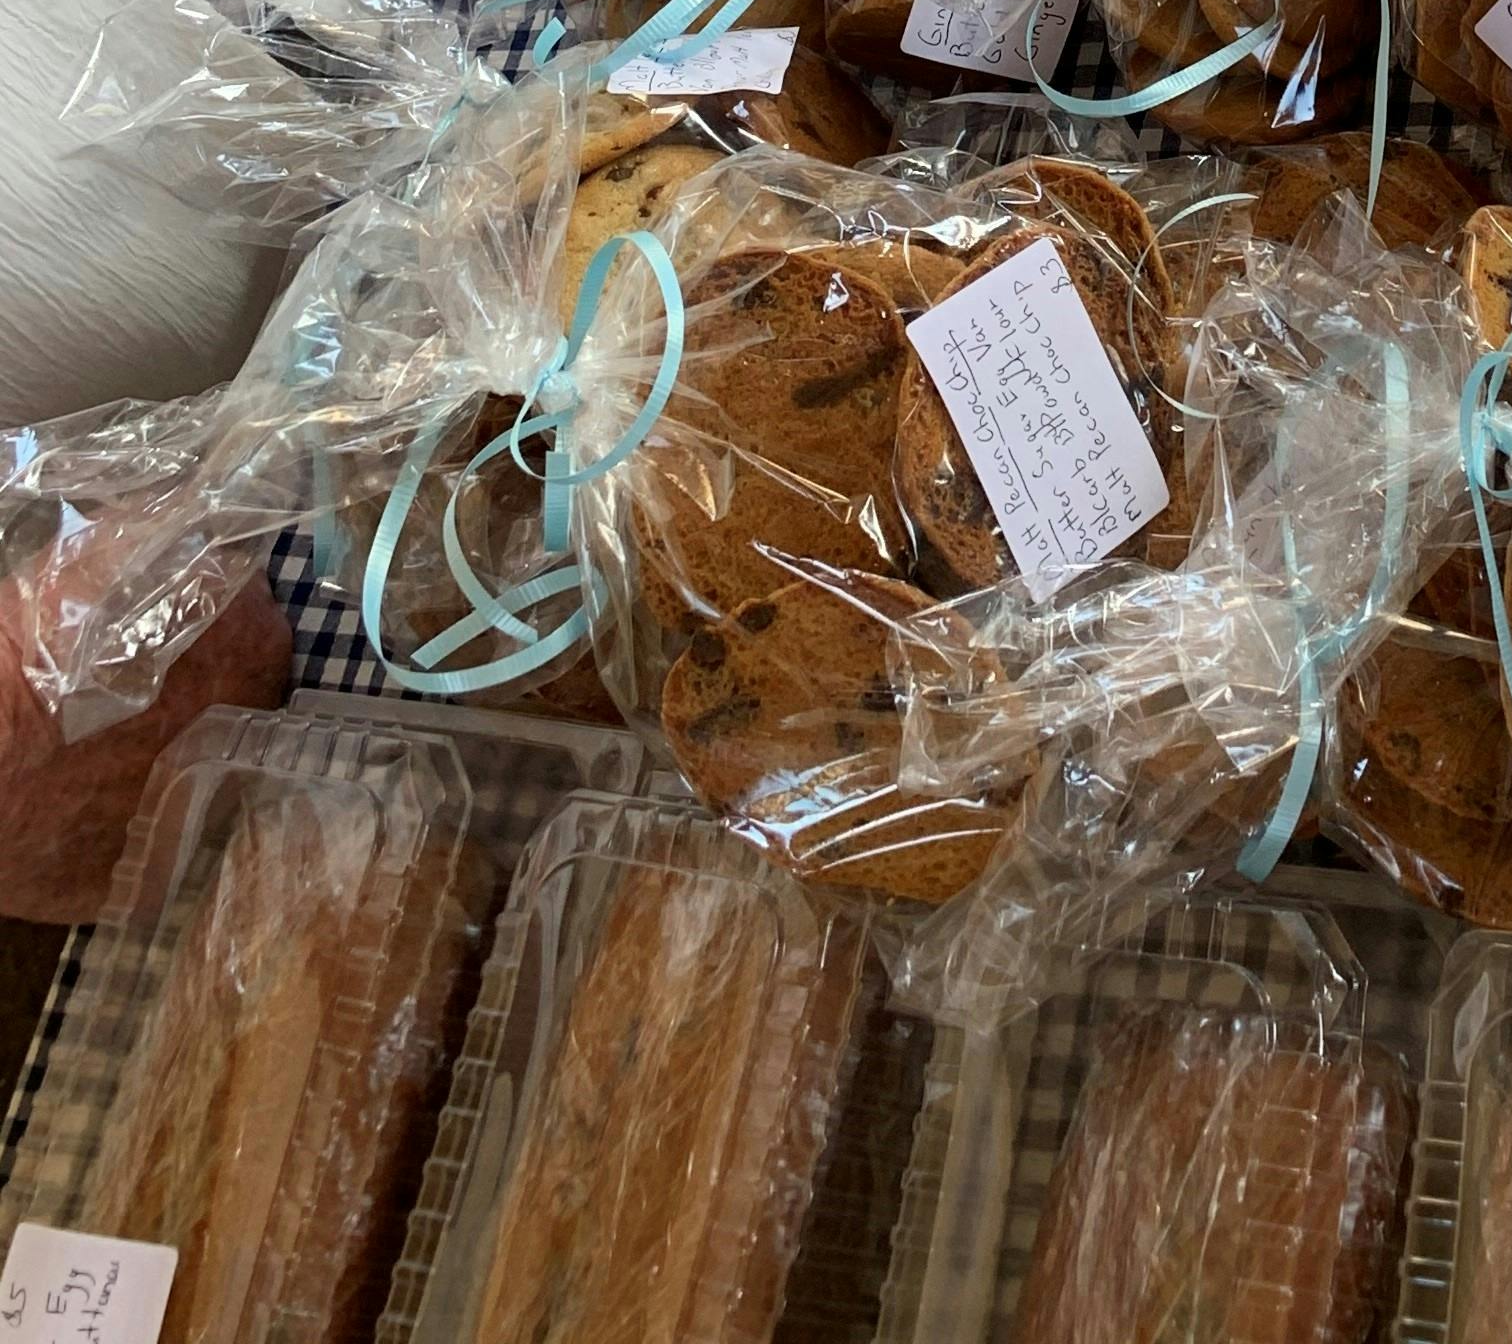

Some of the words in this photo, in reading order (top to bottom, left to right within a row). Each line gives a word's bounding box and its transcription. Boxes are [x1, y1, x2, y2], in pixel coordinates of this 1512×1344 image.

[1040, 336, 1071, 384] Choc
[965, 391, 995, 443] Choc
[1073, 390, 1113, 461] Pecan
[992, 449, 1027, 516] Pecan
[46, 1267, 97, 1314] Egg
